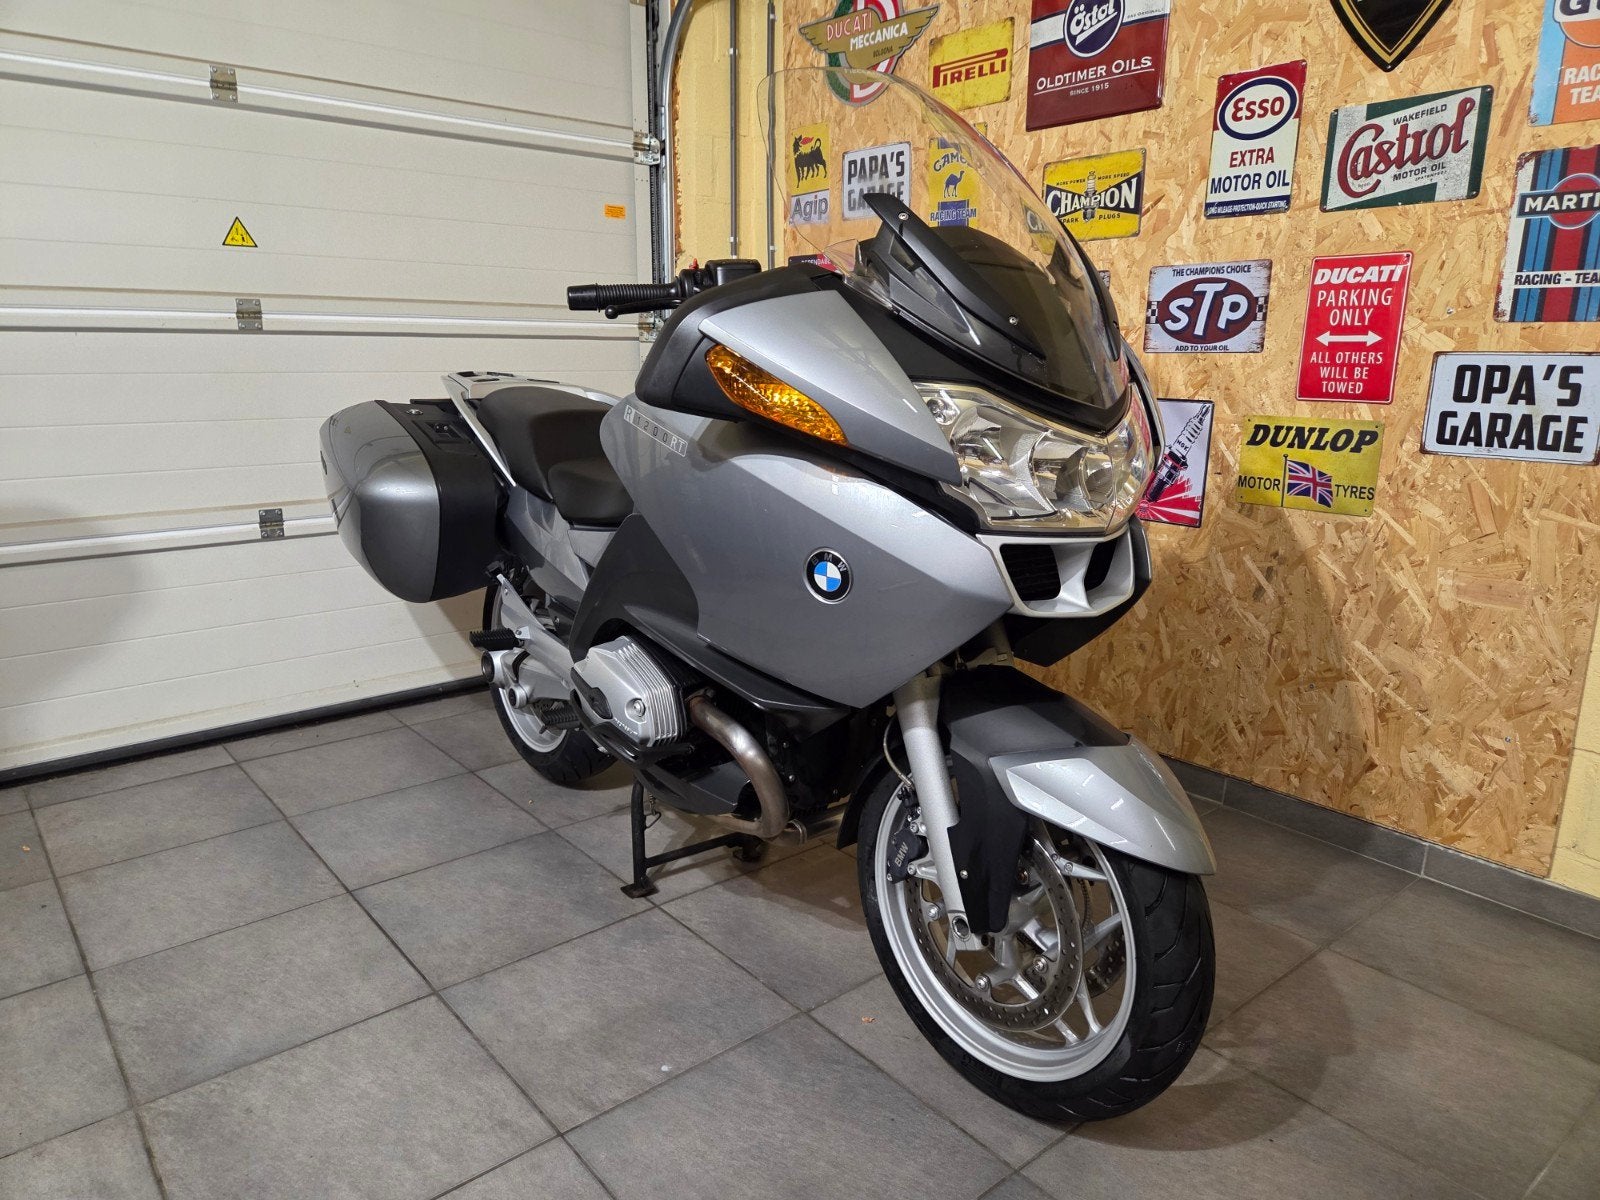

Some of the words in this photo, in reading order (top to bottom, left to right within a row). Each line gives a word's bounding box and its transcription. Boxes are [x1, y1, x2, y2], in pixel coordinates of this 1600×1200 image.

[827, 12, 872, 41] DUCATI
[849, 22, 909, 51] MECCANICA
[933, 48, 1008, 88] PIRELLI
[1036, 65, 1107, 90] OLDTIMER
[1111, 56, 1152, 73] OILS
[1070, 87, 1089, 96] SINCE
[1091, 82, 1109, 92] 1915
[1393, 104, 1447, 126] WAKEFIELD
[1229, 146, 1275, 168] EXTRA
[1337, 97, 1476, 198] Castrol
[848, 150, 905, 185] PAPA'S
[1392, 168, 1427, 182] MOTOR
[1430, 161, 1447, 173] OIL
[1210, 173, 1262, 194] MOTOR
[1266, 169, 1290, 188] OIL
[1046, 177, 1138, 217] CHAMPION
[790, 195, 828, 222] Agip
[930, 209, 957, 221] RACING
[957, 208, 977, 219] TEAM
[1172, 268, 1184, 277] THE
[1185, 265, 1225, 277] CHAMPIONS
[1226, 264, 1252, 274] CHOICE
[1314, 264, 1403, 285] DUCATI
[1514, 272, 1561, 286] RACING
[1317, 288, 1393, 307] PARKING
[1164, 282, 1249, 337] STP
[1329, 308, 1373, 326] ONLY
[1310, 351, 1331, 364] ALL
[1336, 351, 1383, 364] OTHERS
[1320, 366, 1348, 379] WILL
[1354, 367, 1369, 379] BE
[1322, 382, 1363, 394] TOWED
[1452, 364, 1584, 407] OPA'S
[1246, 424, 1379, 453] DUNLOP
[1436, 411, 1588, 453] GARAGE
[1238, 475, 1281, 491] MOTOR
[1334, 484, 1375, 500] TYRES
[810, 552, 847, 572] BMW
[895, 841, 909, 867] BMW
